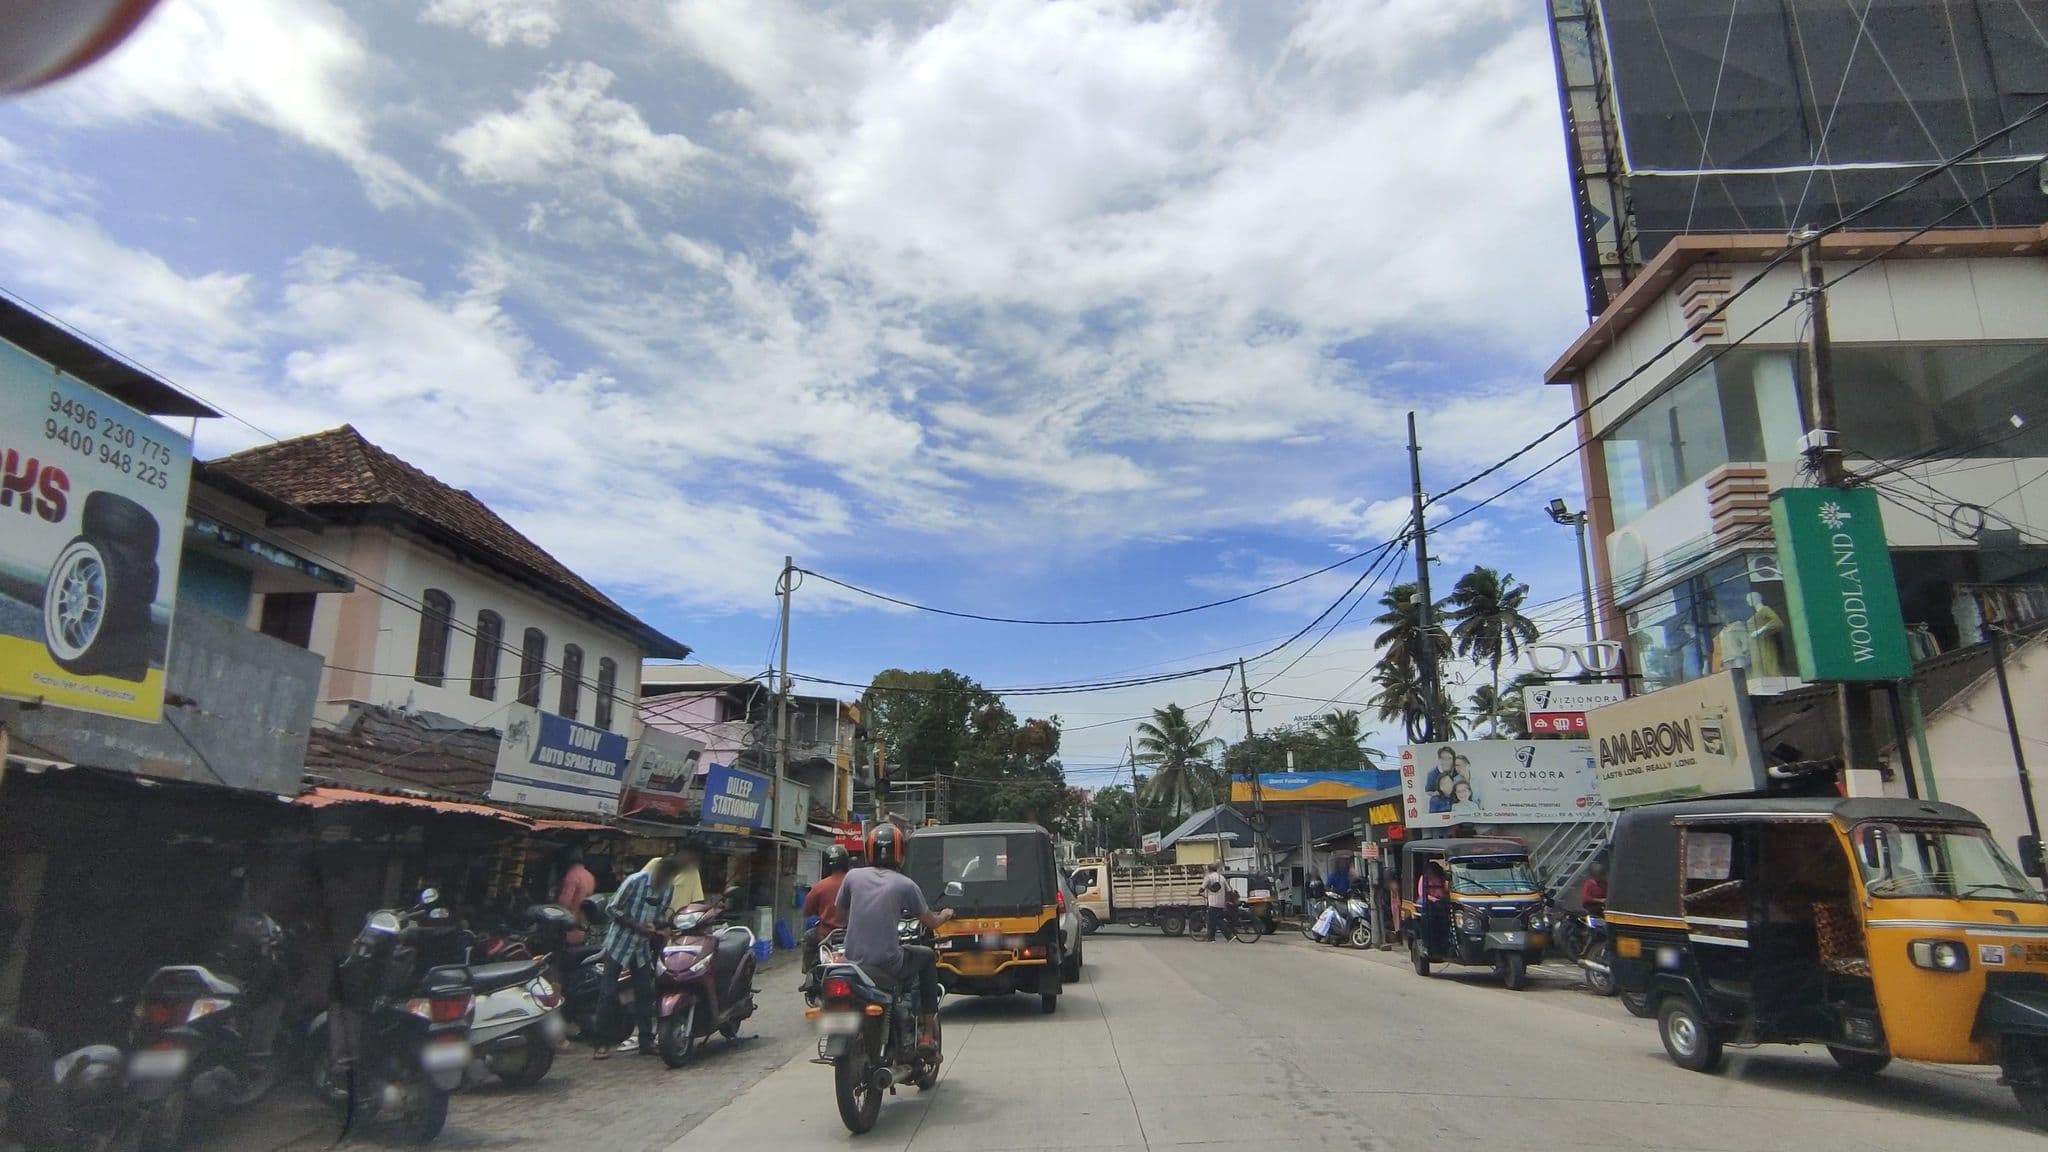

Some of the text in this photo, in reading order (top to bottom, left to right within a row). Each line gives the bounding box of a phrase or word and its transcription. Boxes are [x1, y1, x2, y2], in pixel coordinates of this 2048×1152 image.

[50, 391, 170, 465] 9496 230 775
[45, 418, 167, 490] 9400 948 225
[1832, 533, 1875, 663] WOODLAND
[1553, 695, 1619, 704] VIZIONORA
[1599, 718, 1694, 768] AMARON
[539, 746, 616, 776] AUTO SPARE PARTS
[1491, 770, 1566, 779] VIZIONORA
[1602, 770, 1623, 780] LASTS
[1646, 761, 1672, 772] REALLY
[726, 776, 753, 798] DILEEP
[711, 794, 760, 820] STATIONARY
